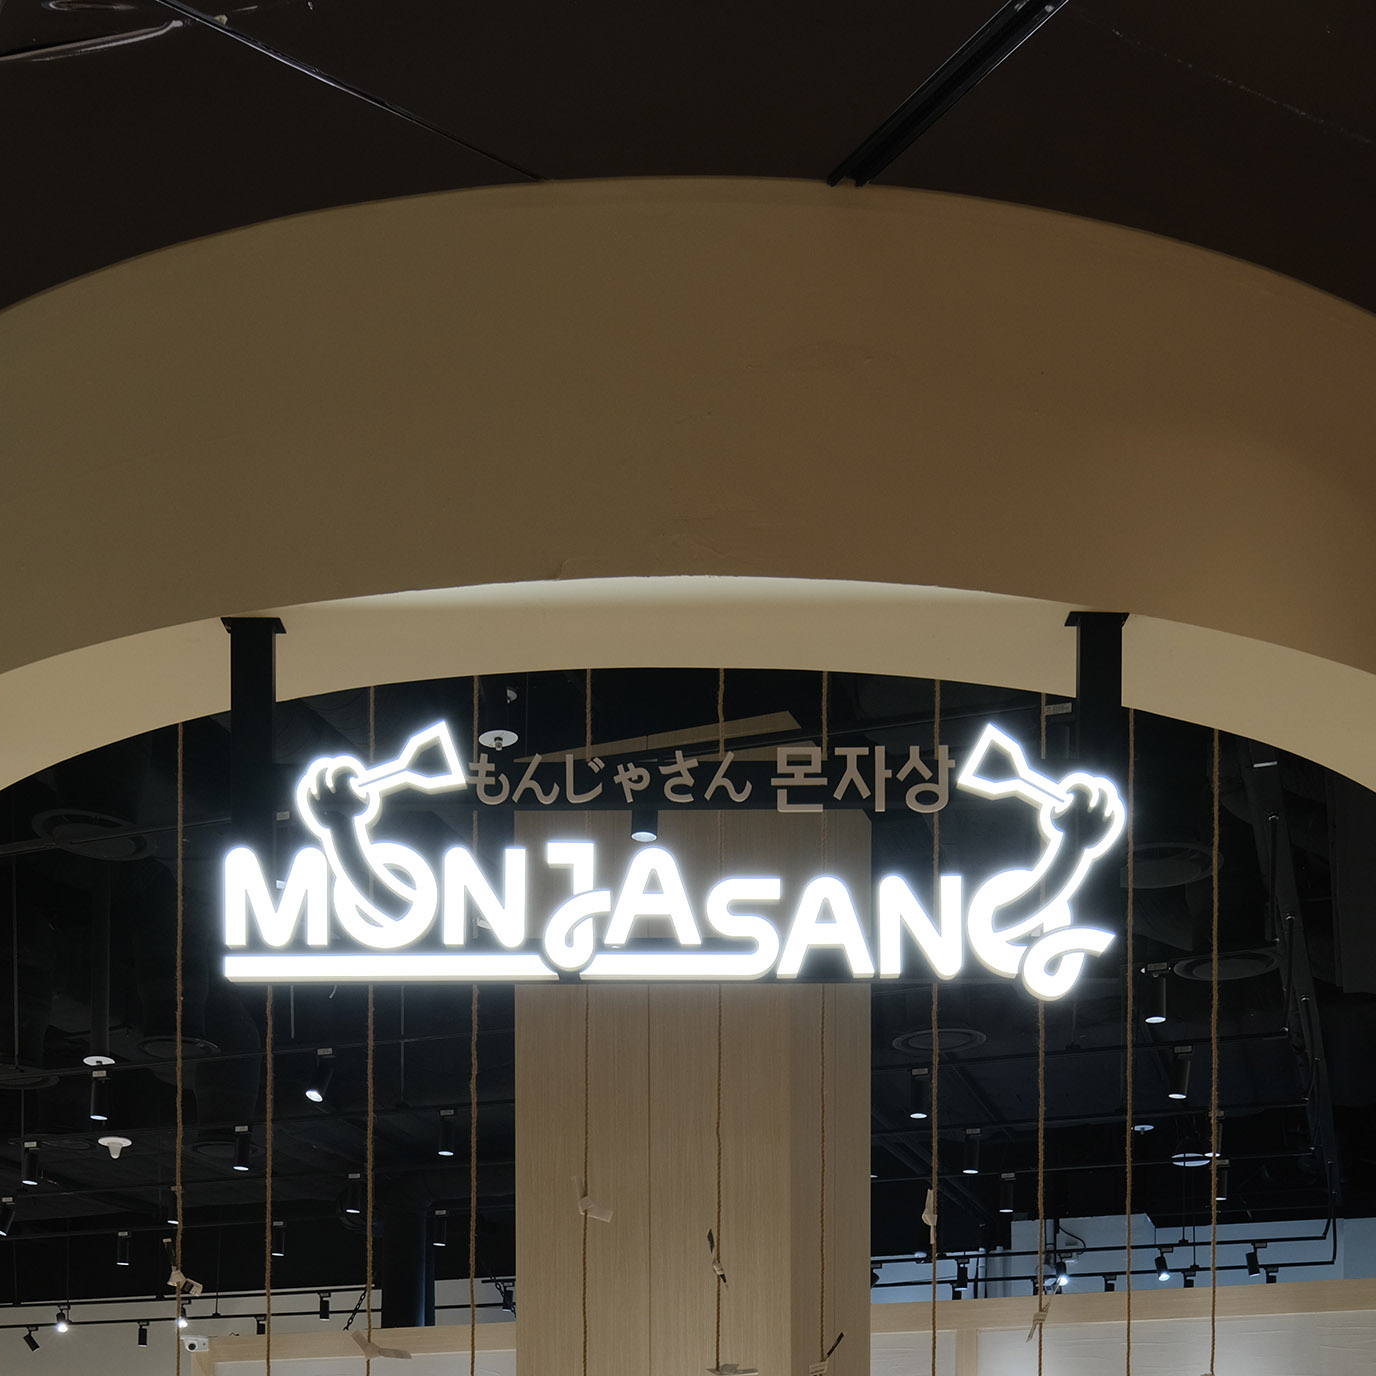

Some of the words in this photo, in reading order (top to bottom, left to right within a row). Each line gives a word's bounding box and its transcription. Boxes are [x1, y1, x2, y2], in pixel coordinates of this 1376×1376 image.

[467, 751, 753, 806] もんじゃさん
[770, 744, 956, 814] 몬자상
